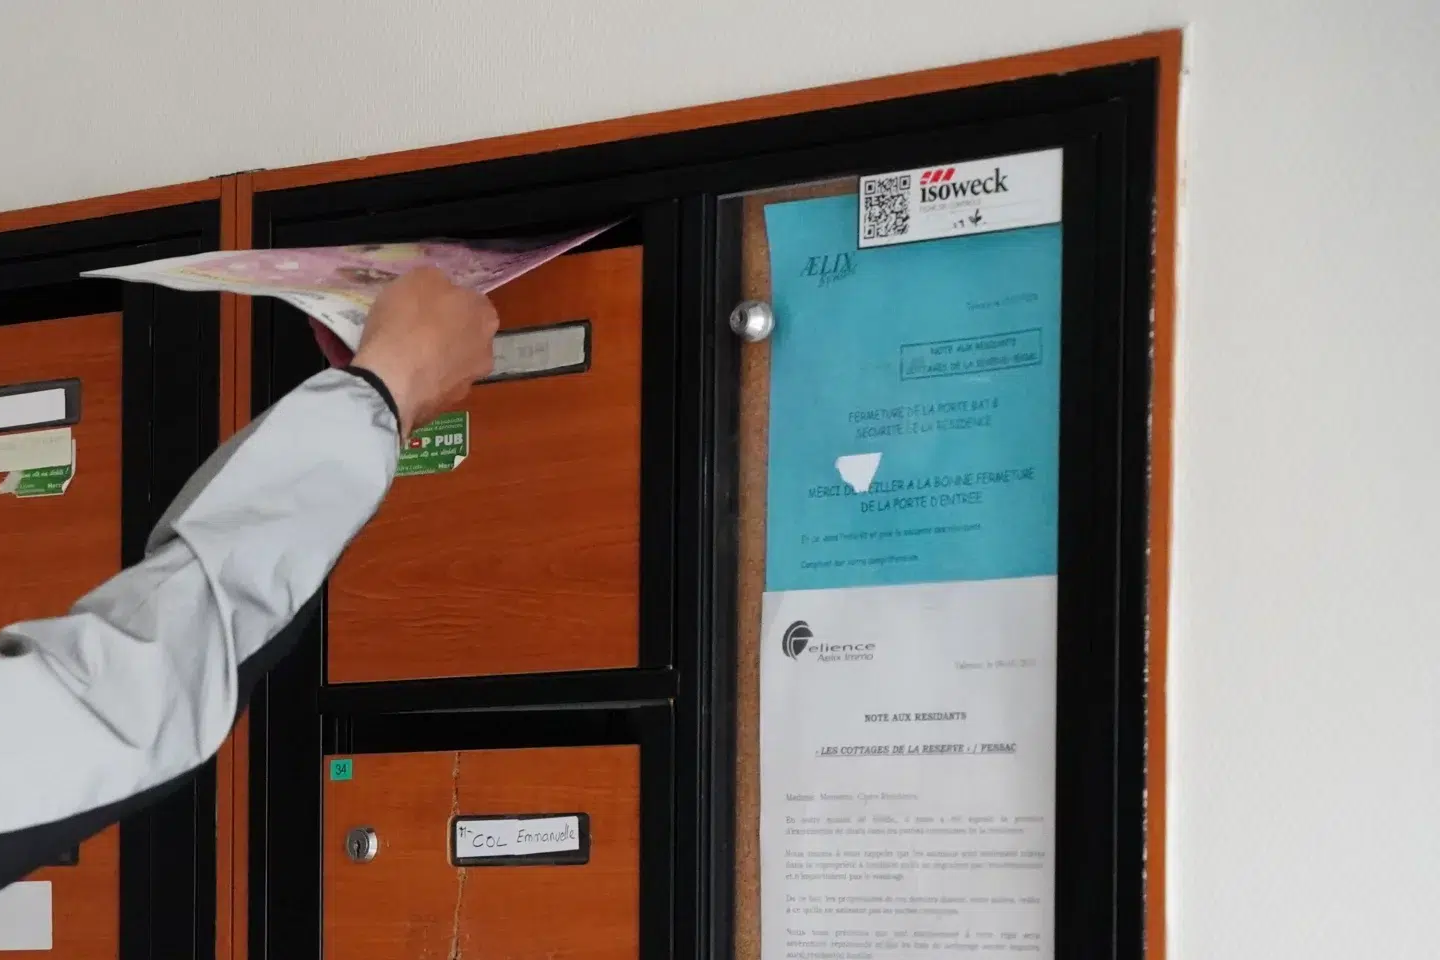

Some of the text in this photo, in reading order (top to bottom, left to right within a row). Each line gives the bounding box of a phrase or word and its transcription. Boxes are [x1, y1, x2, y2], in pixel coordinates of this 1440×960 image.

[919, 167, 1009, 203] isoweck
[435, 433, 464, 448] PUB
[864, 713, 889, 723] NOTE
[892, 712, 911, 722] AUX
[820, 746, 838, 755] LES
[840, 745, 890, 755] COTTAGES
[893, 745, 906, 754] DE
[907, 745, 921, 754] LA
[335, 764, 347, 775] 34
[472, 834, 507, 848] COL
